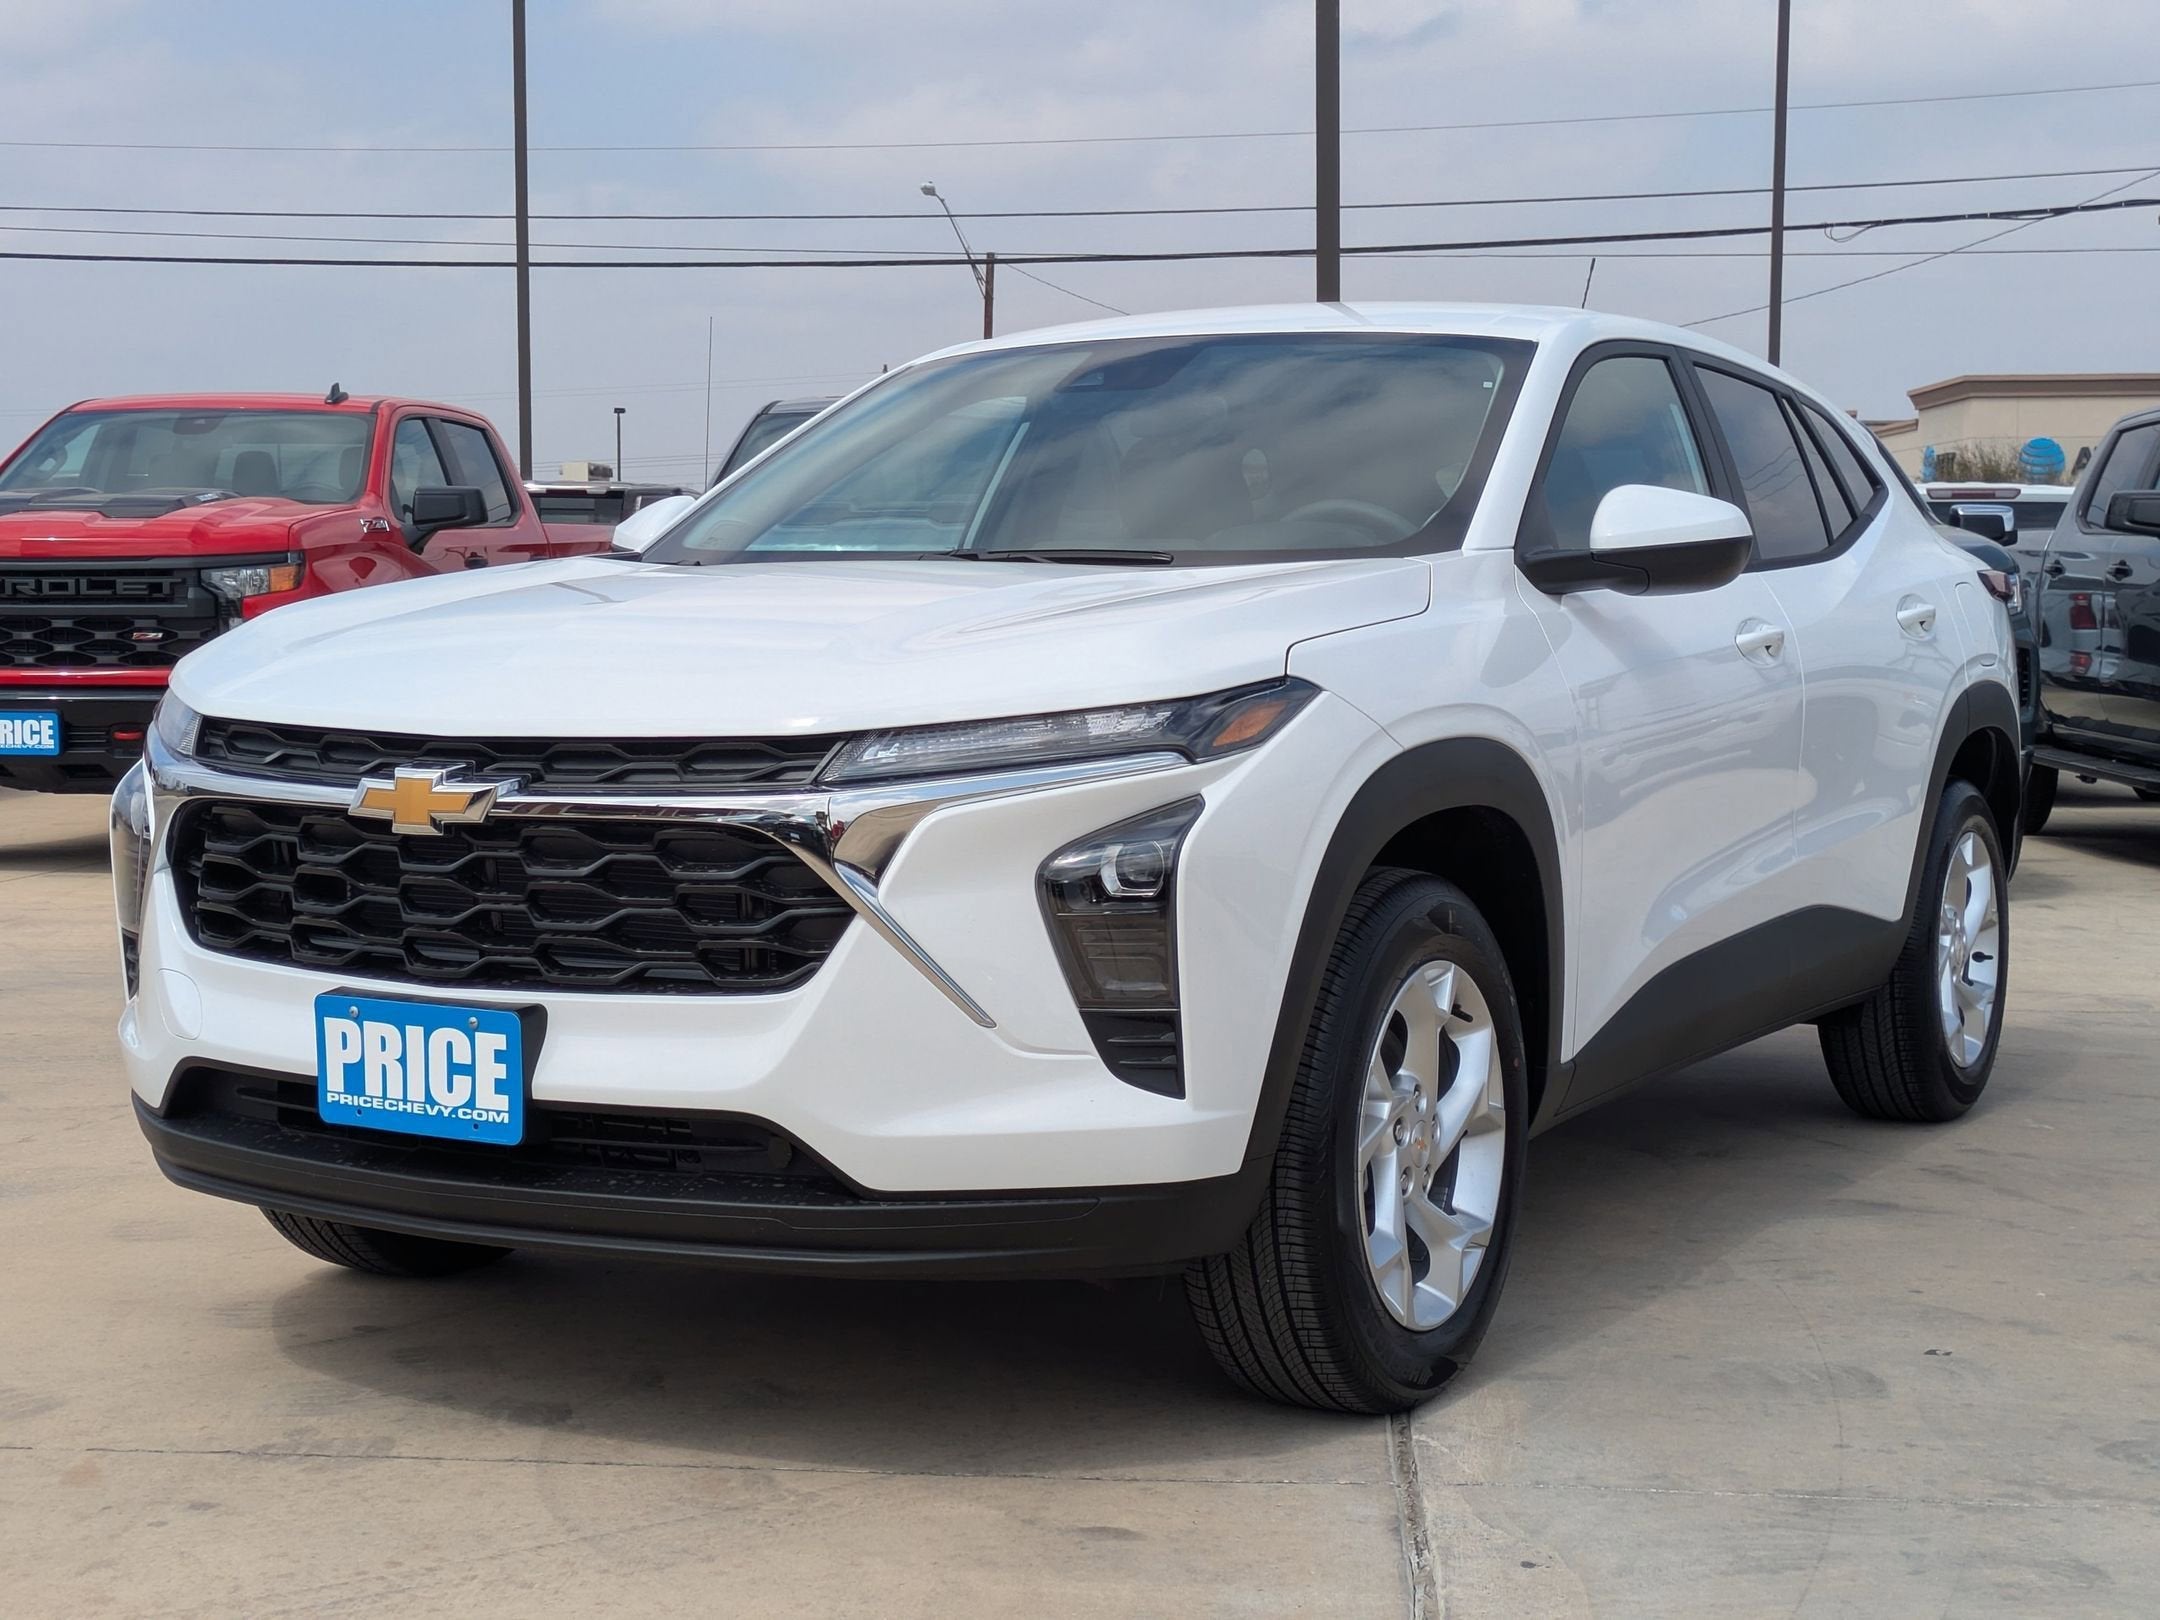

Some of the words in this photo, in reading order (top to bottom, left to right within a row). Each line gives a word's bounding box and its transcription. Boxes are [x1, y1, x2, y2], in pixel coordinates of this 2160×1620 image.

[0, 719, 54, 745] RICE
[323, 1016, 509, 1112] PRICE
[326, 1092, 510, 1124] PRICECHEVY.COM
